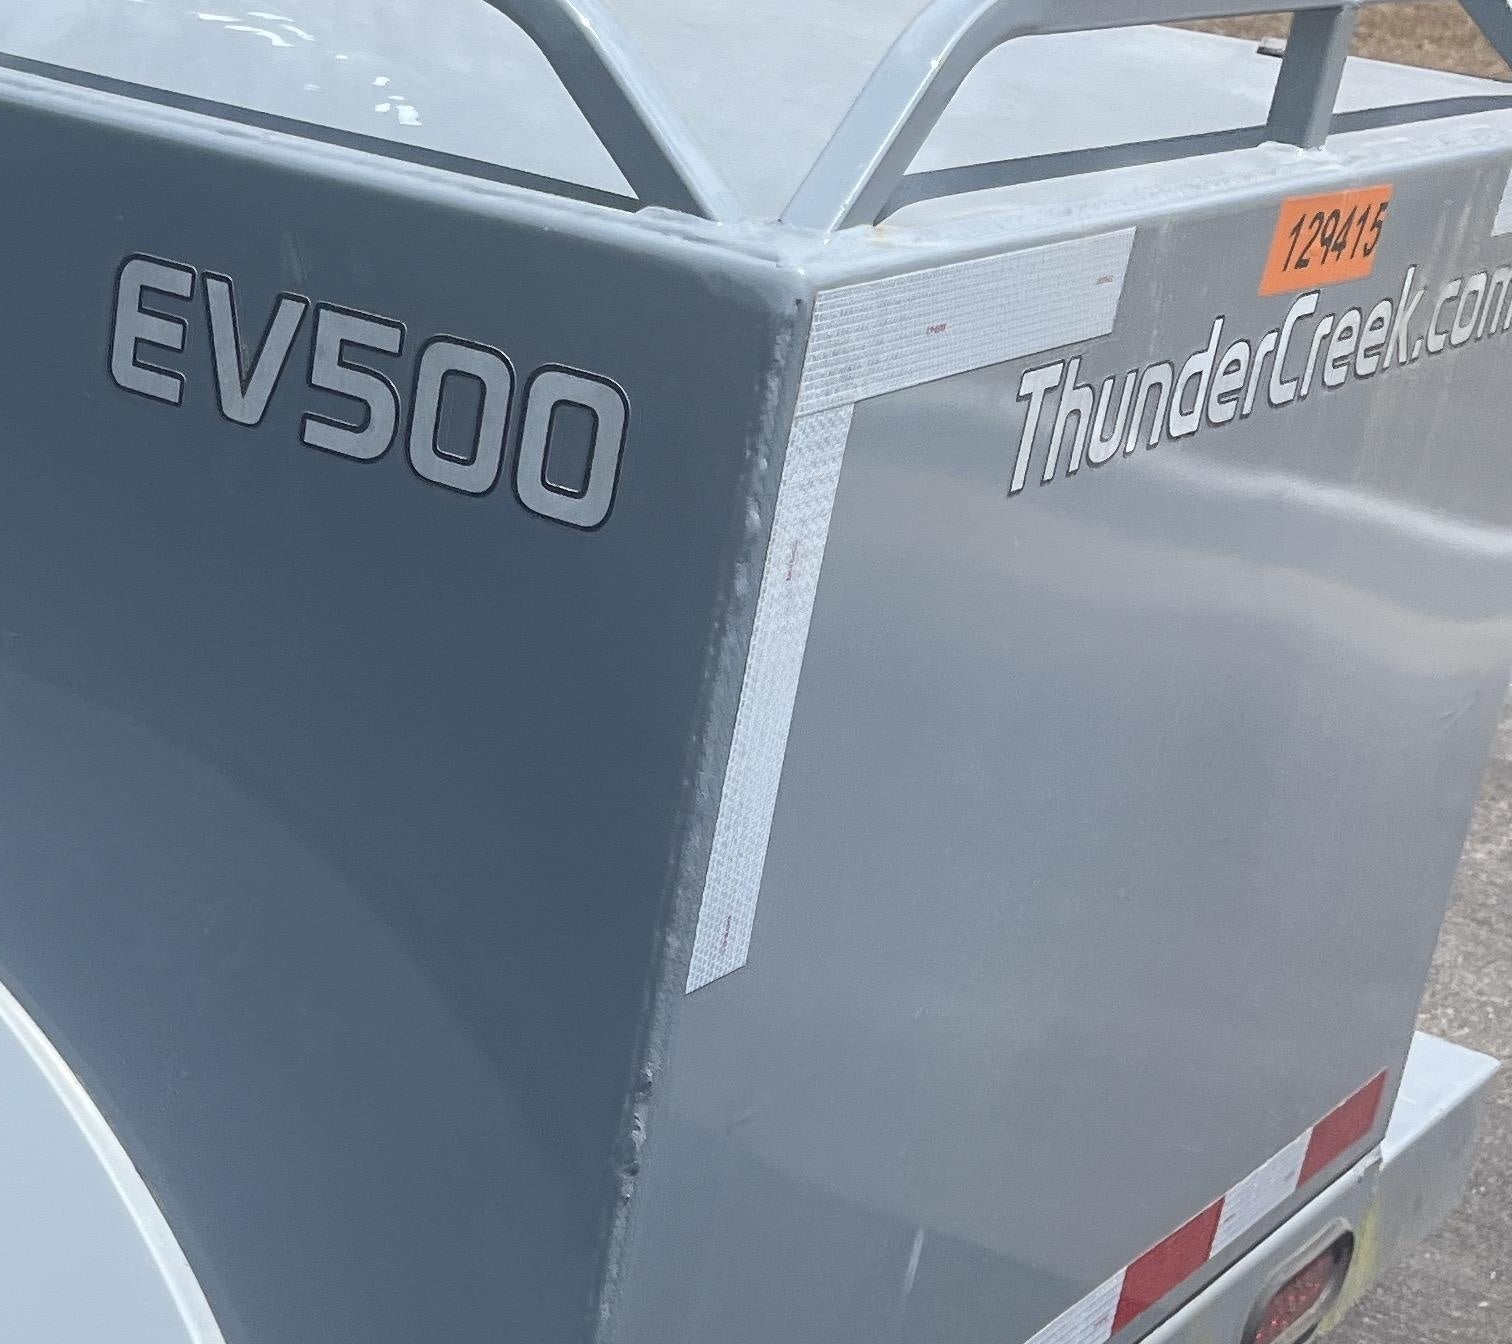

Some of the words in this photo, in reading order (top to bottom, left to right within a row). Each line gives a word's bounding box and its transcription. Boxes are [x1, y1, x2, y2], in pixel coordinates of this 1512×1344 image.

[1281, 201, 1389, 273] 129415
[107, 251, 632, 533] EV500
[1006, 263, 1512, 497] ThunderCreek.com
